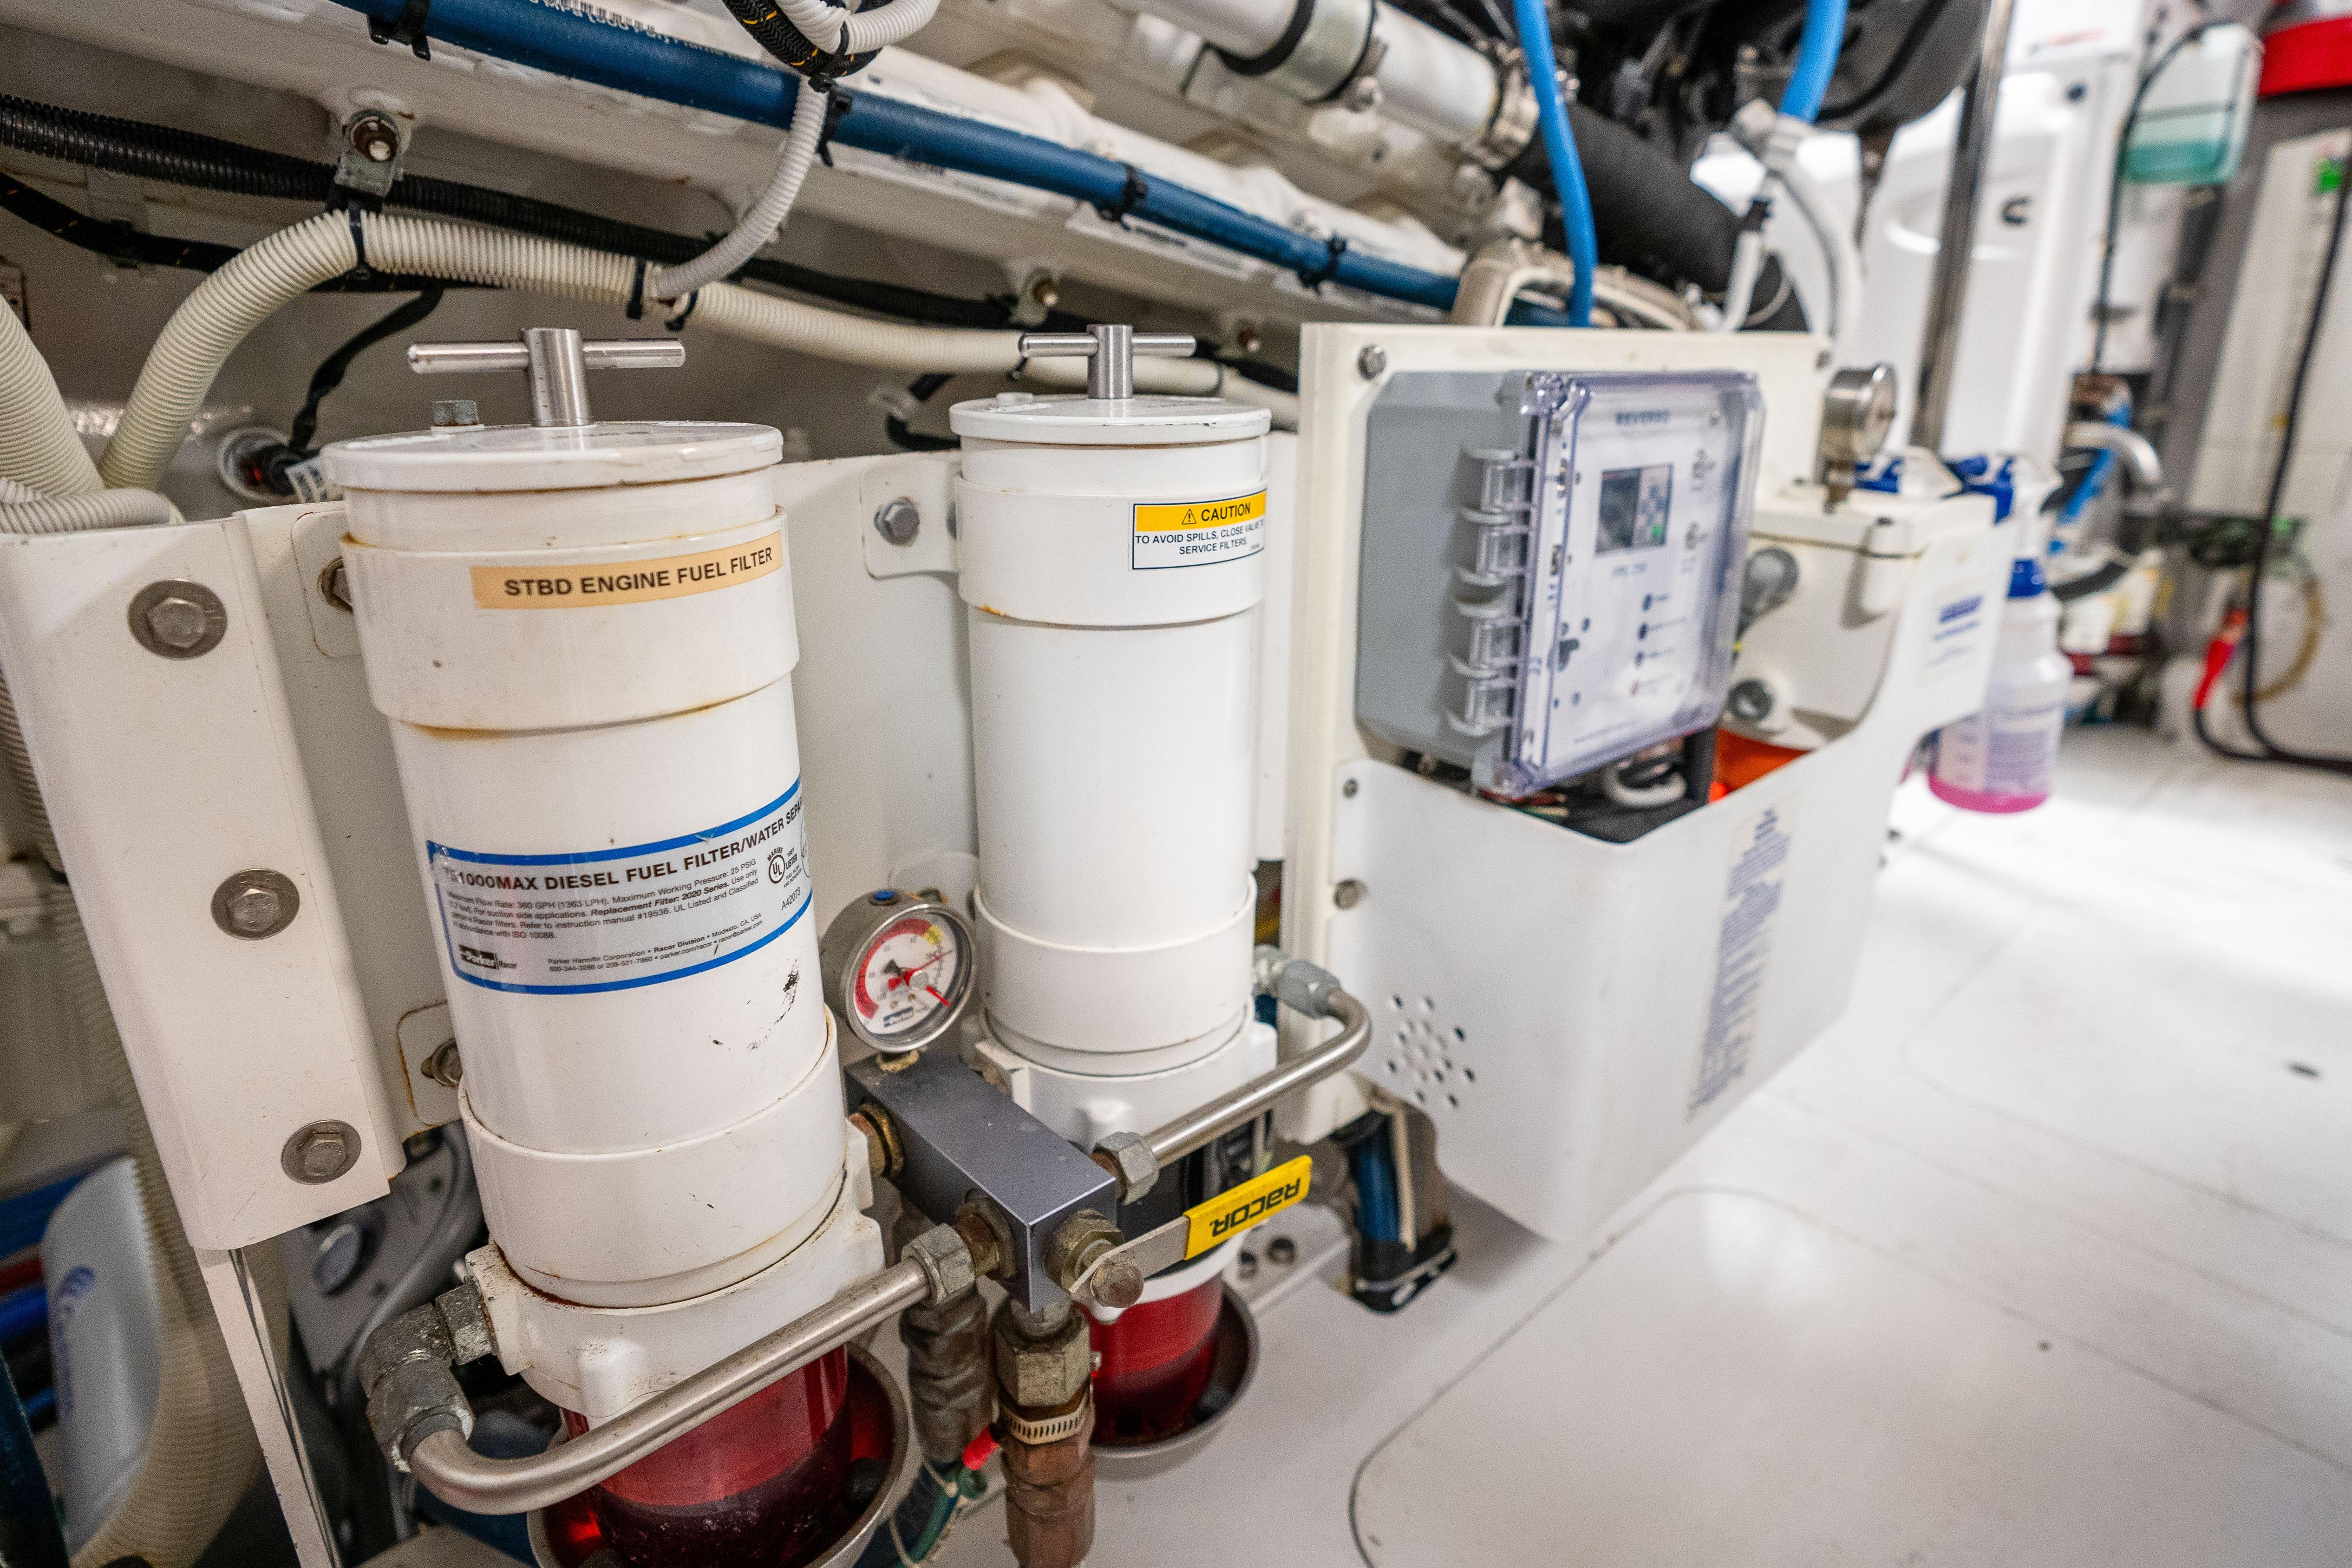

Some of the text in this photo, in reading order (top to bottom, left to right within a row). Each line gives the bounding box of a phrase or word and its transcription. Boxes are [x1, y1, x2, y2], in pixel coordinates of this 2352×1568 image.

[1201, 502, 1250, 522] CAUTION
[1135, 536, 1150, 544] TO
[1152, 534, 1183, 543] AVOID
[1221, 526, 1243, 537] CLOSE
[1179, 543, 1217, 555] SERVICE
[504, 547, 773, 596] STBD ENGINE FUEL FILTER
[544, 872, 619, 890] DIESEL
[626, 862, 678, 882] FUEL
[683, 817, 784, 870] FILTER/WATER
[767, 847, 783, 862] MARINE
[772, 862, 782, 875] UL
[785, 853, 797, 870] LISTED
[475, 897, 493, 906] Flow
[557, 900, 581, 910] (1363
[612, 891, 655, 904] Maximum
[658, 883, 692, 895] Working
[694, 871, 729, 887] Pressure:
[731, 866, 739, 875] 25
[740, 858, 756, 871] PSIG
[486, 910, 513, 919] suction
[534, 911, 588, 921] applications.
[591, 902, 652, 916] Replacement
[654, 896, 679, 907] Filter:
[681, 889, 702, 901] 2020
[703, 882, 729, 895] Series.
[731, 875, 744, 884] Use
[746, 869, 758, 879] only
[782, 886, 801, 911] A42073
[555, 919, 601, 929] instruction
[603, 914, 634, 925] manual
[637, 907, 671, 920] #19536.
[673, 904, 686, 912] UL
[687, 896, 712, 909] Listed
[713, 891, 727, 901] and
[728, 877, 758, 895] Classified
[603, 950, 645, 961] Corporation
[653, 944, 675, 953] Racor
[677, 936, 705, 947] Division
[712, 925, 739, 938] Modesto,
[751, 912, 762, 921] USA
[605, 956, 653, 968] 209-521-7860
[660, 942, 712, 960] parker.com/racor
[718, 920, 763, 943] racor@parker.com
